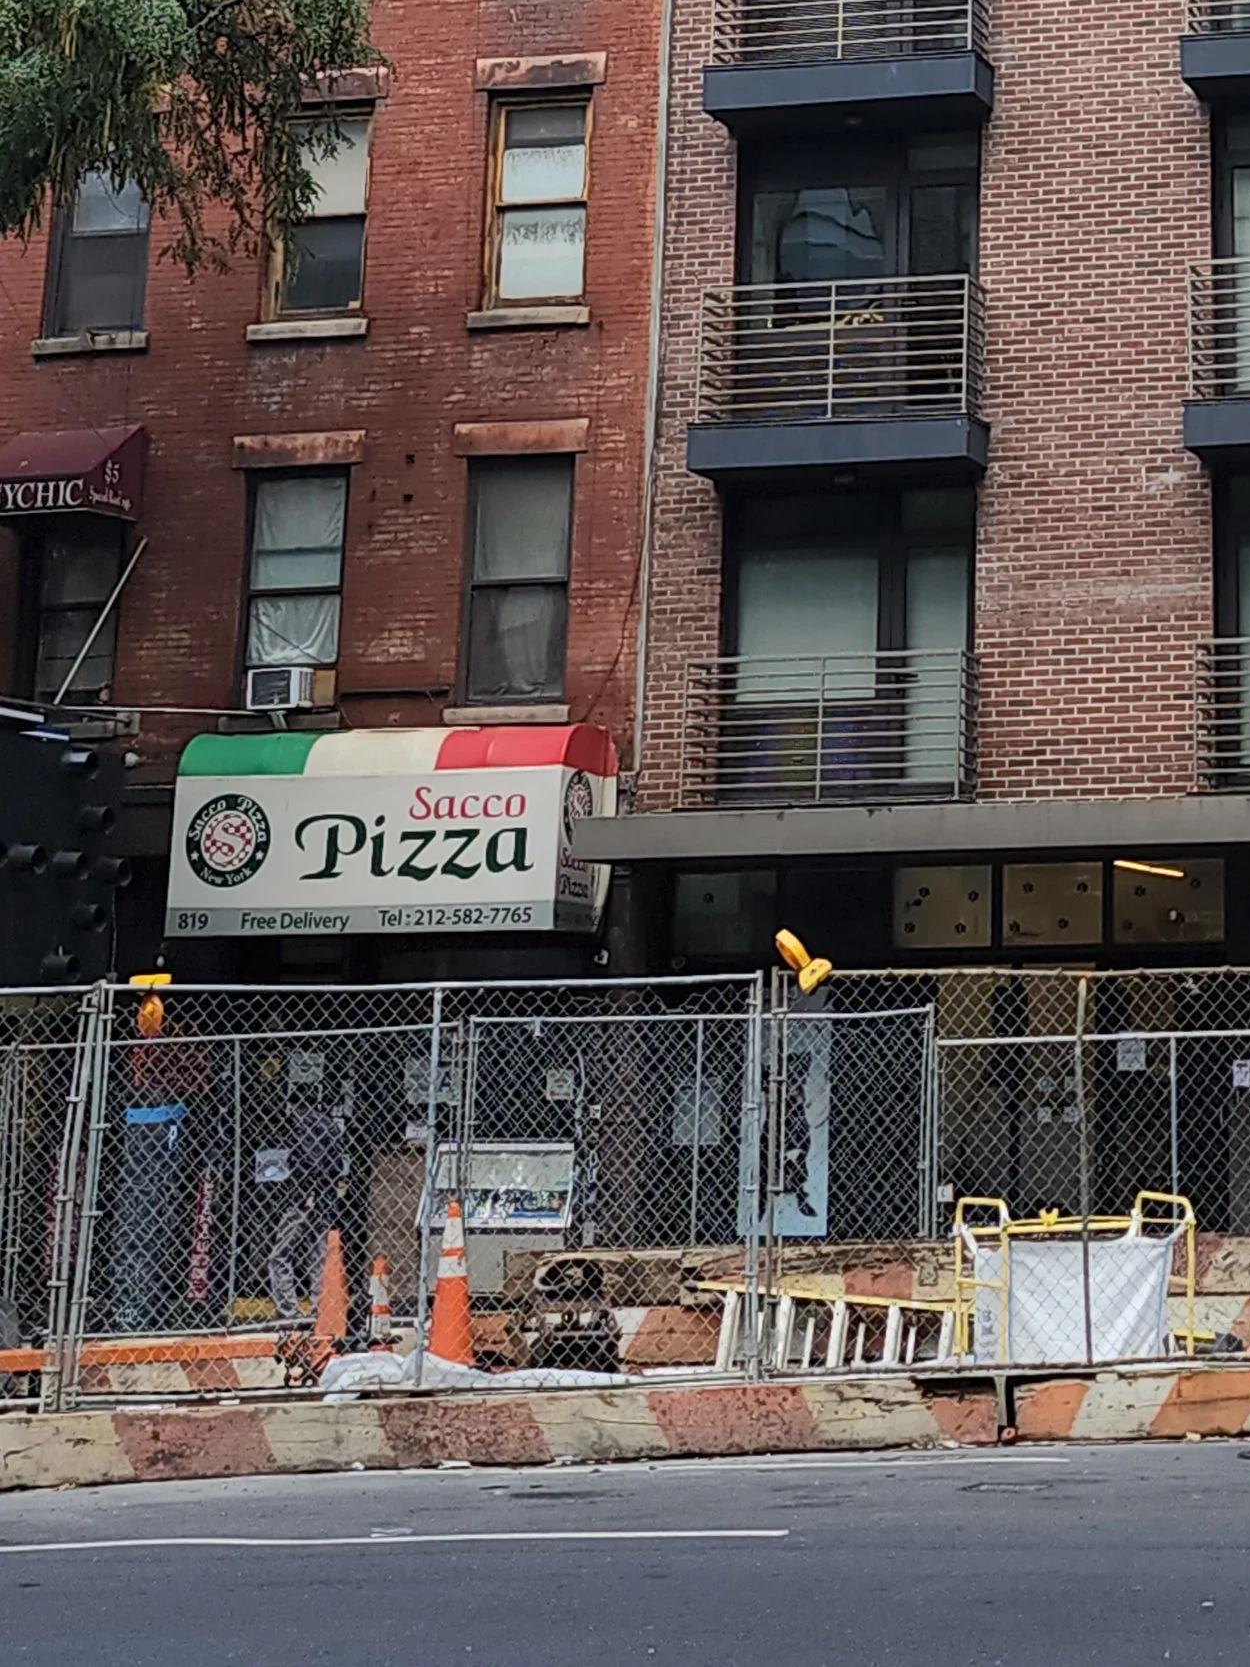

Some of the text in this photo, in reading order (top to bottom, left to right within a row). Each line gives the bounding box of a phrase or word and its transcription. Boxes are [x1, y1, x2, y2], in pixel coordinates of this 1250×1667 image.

[0, 479, 84, 509] YCHIC
[188, 796, 267, 842] Sacco Pizza
[408, 786, 527, 820] Sacco
[294, 814, 534, 881] Pizza
[200, 867, 253, 885] New York
[178, 913, 209, 930] 819
[240, 912, 277, 929] Free
[280, 912, 350, 932] Delivery
